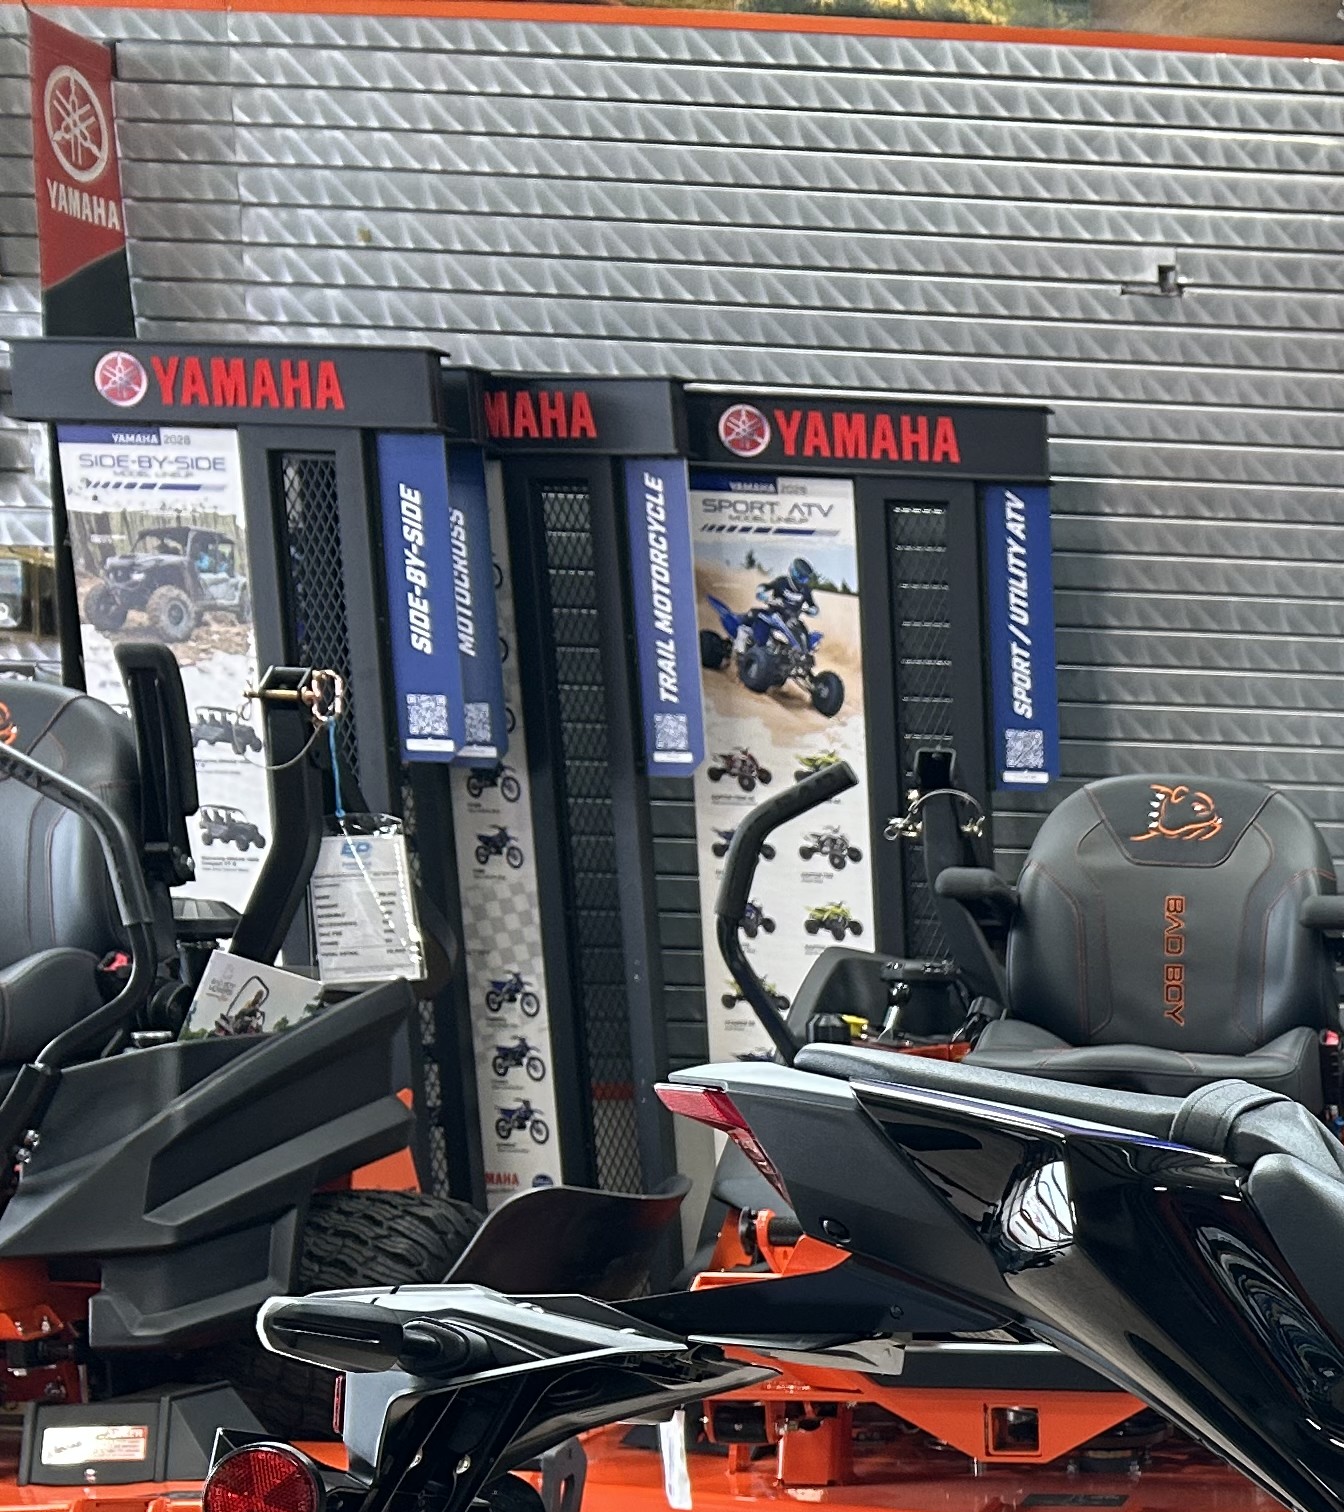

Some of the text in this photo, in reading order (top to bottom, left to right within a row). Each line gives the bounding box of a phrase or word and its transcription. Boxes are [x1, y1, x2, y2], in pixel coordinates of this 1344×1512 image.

[46, 178, 121, 231] YAMAHA
[150, 355, 345, 410] YAMAHA
[79, 453, 227, 472] SIDE-BY-SIDE
[112, 433, 160, 444] YAMAHA
[773, 408, 962, 464] YAMAHA
[702, 498, 834, 518] SPORT ATV
[1003, 489, 1027, 540] ATV
[399, 482, 434, 656] SIDE-BY-SIDE
[449, 506, 477, 657] MOTOCROSS
[644, 472, 681, 704] TRAIL MOTORCYCLE
[1005, 540, 1030, 627] UTILITY
[1011, 645, 1033, 720] SPORT
[1164, 895, 1185, 1027] BAD BOY
